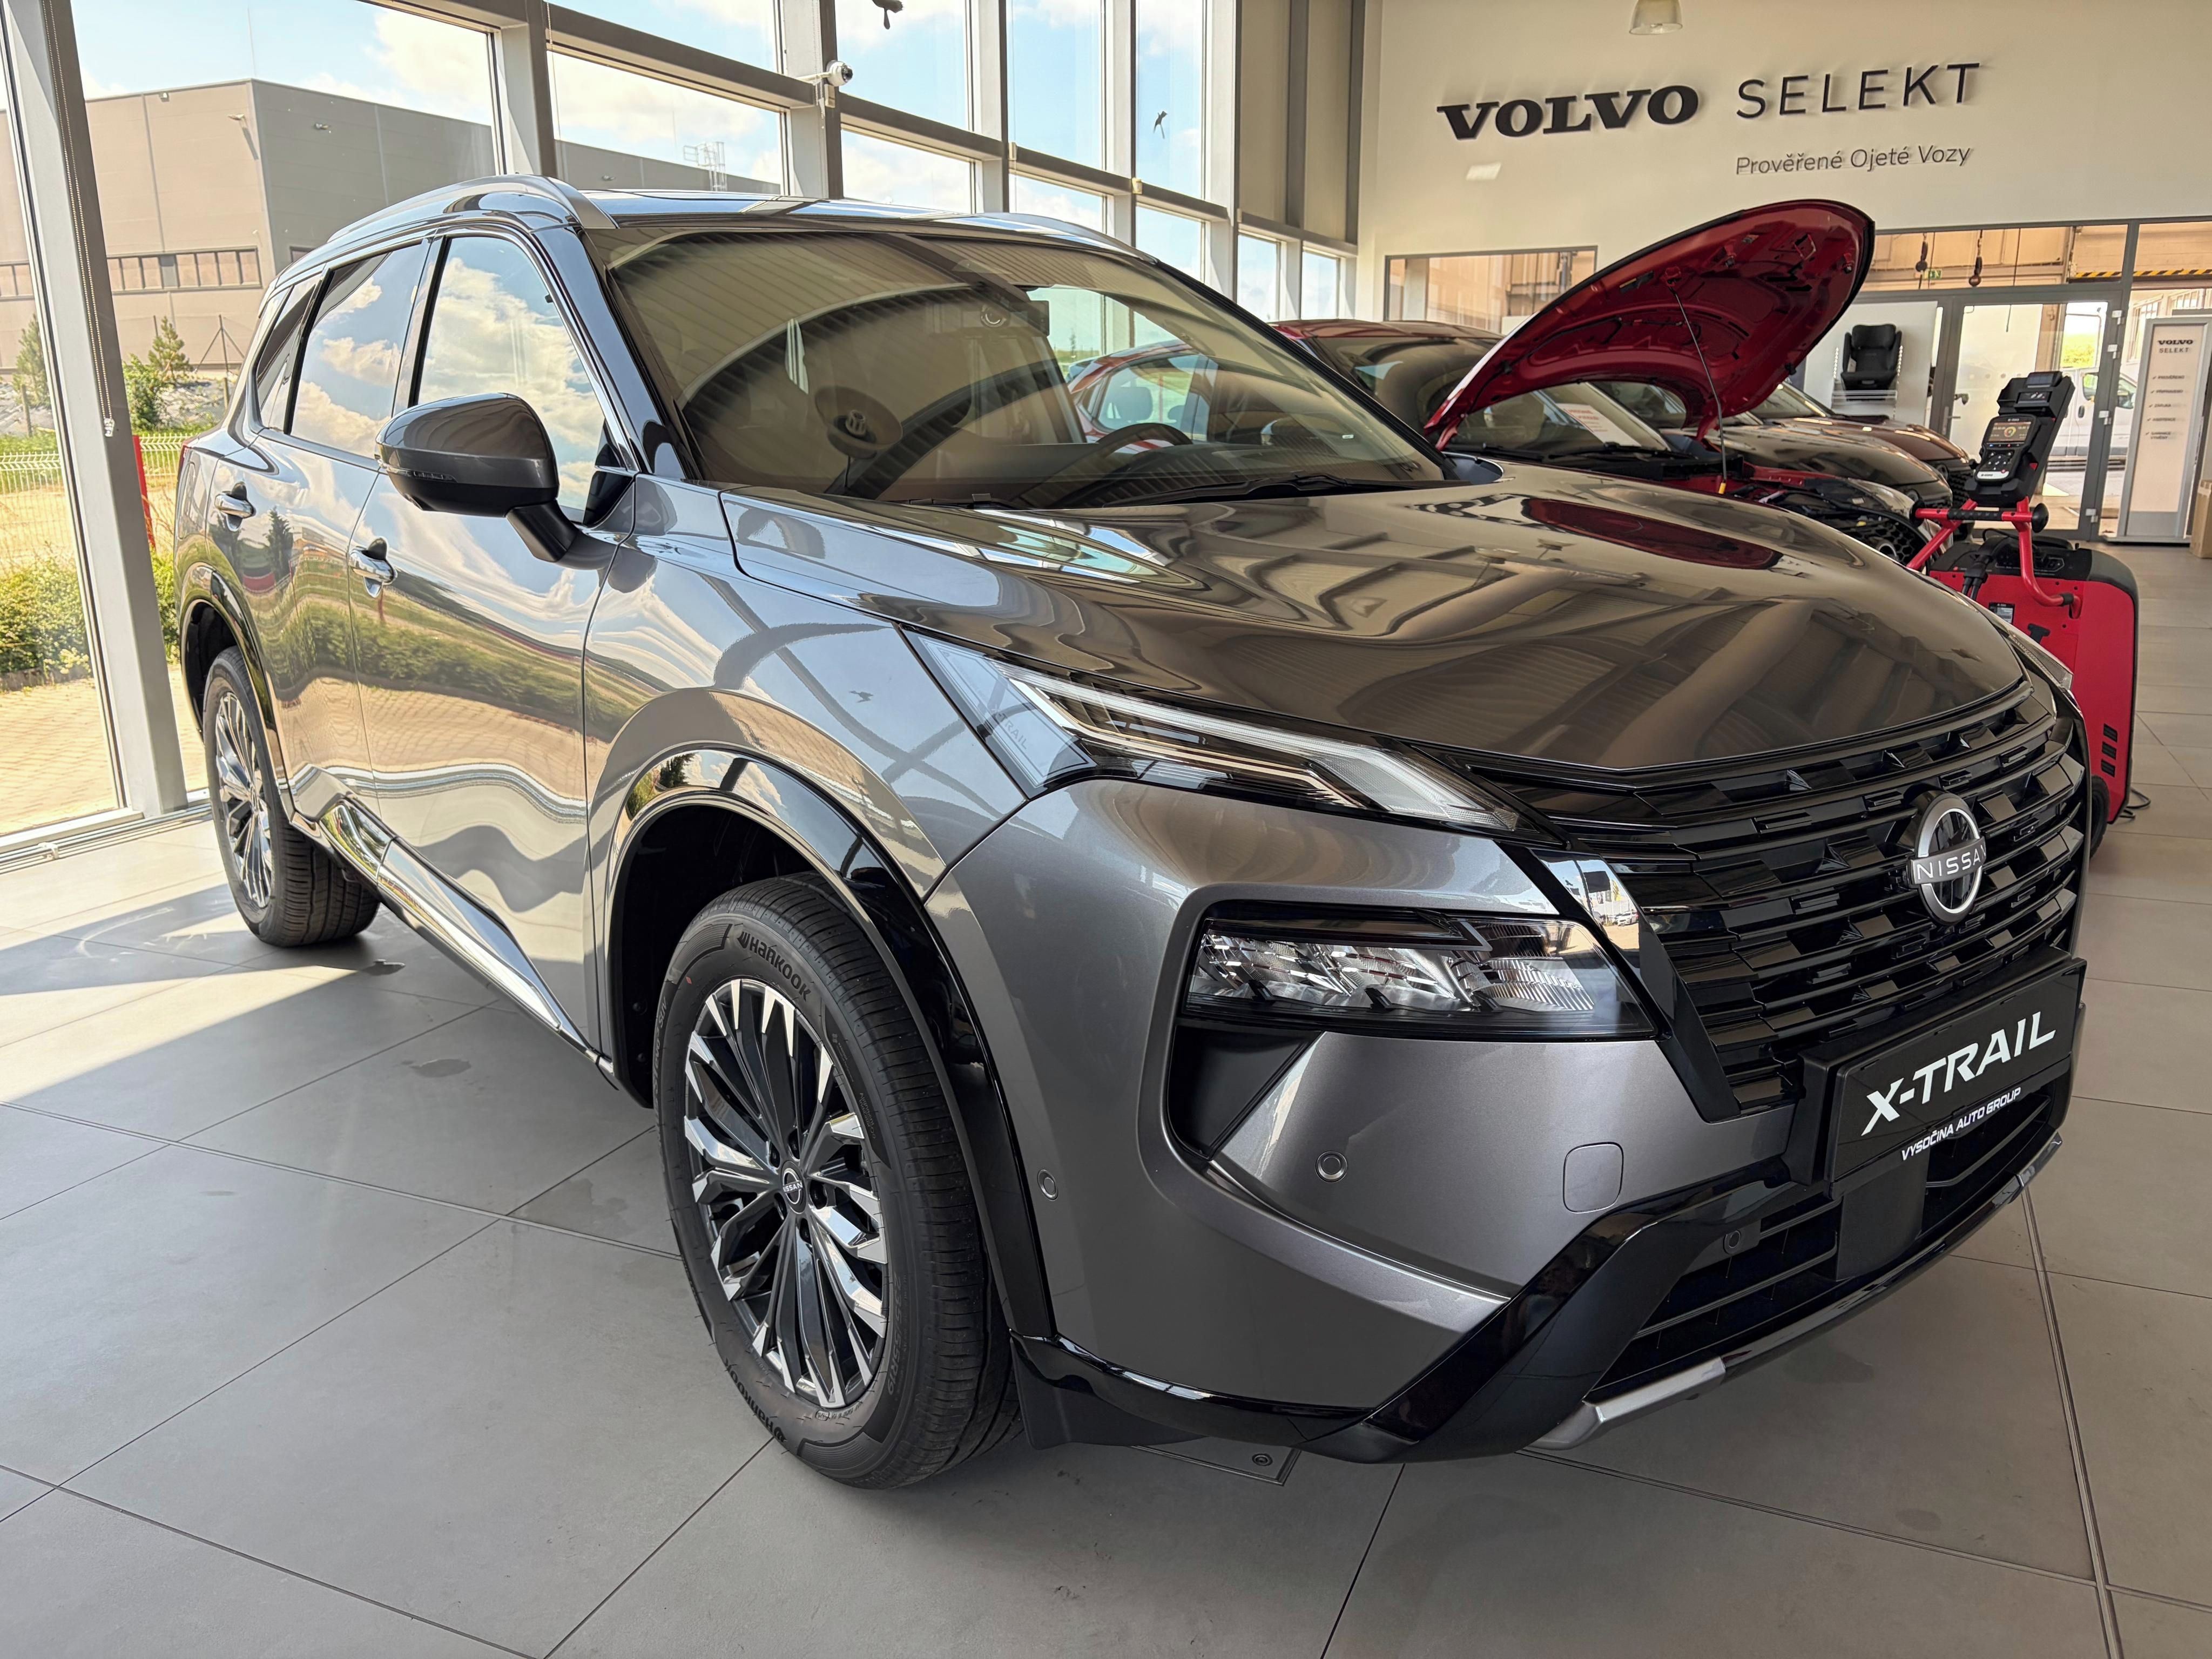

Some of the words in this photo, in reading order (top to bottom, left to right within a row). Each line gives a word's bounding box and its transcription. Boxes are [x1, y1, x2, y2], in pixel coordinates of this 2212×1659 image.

[1437, 85, 1698, 139] VOLVO
[1736, 62, 1980, 119] SELEKT
[1736, 150, 1843, 174] Prověřené
[1850, 146, 1908, 172] Ojeté
[1918, 145, 1971, 166] Vozy
[1862, 1011, 2056, 1136] X-TRAIL
[1901, 1123, 1953, 1161] VYSOČINA
[1956, 1105, 1985, 1131] AUTO
[1986, 1087, 2021, 1114] GROUP
[887, 1271, 902, 1396] 235/55R19
